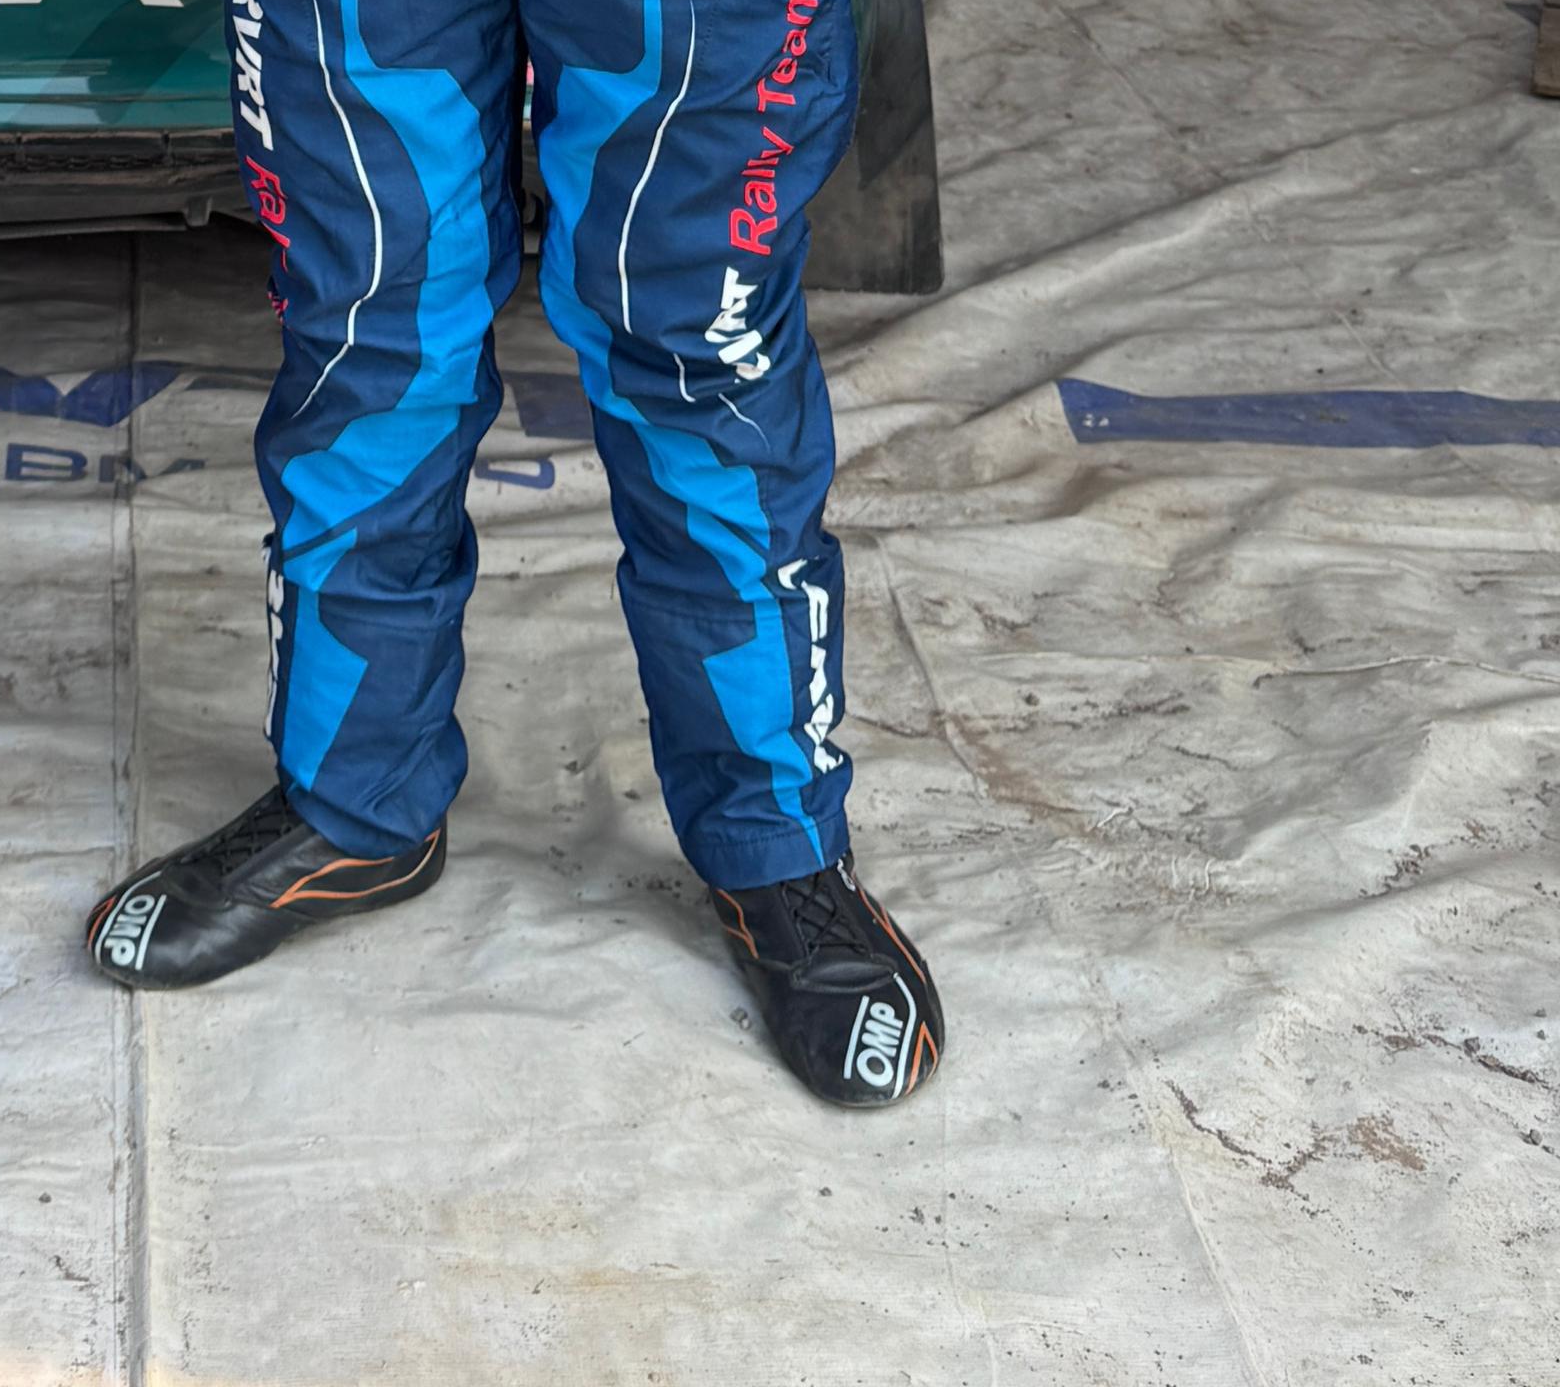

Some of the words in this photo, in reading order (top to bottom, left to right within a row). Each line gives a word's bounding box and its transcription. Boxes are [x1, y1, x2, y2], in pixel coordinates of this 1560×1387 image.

[729, 126, 795, 257] Rally
[103, 894, 156, 967] OMP
[855, 1001, 904, 1087] OMP
